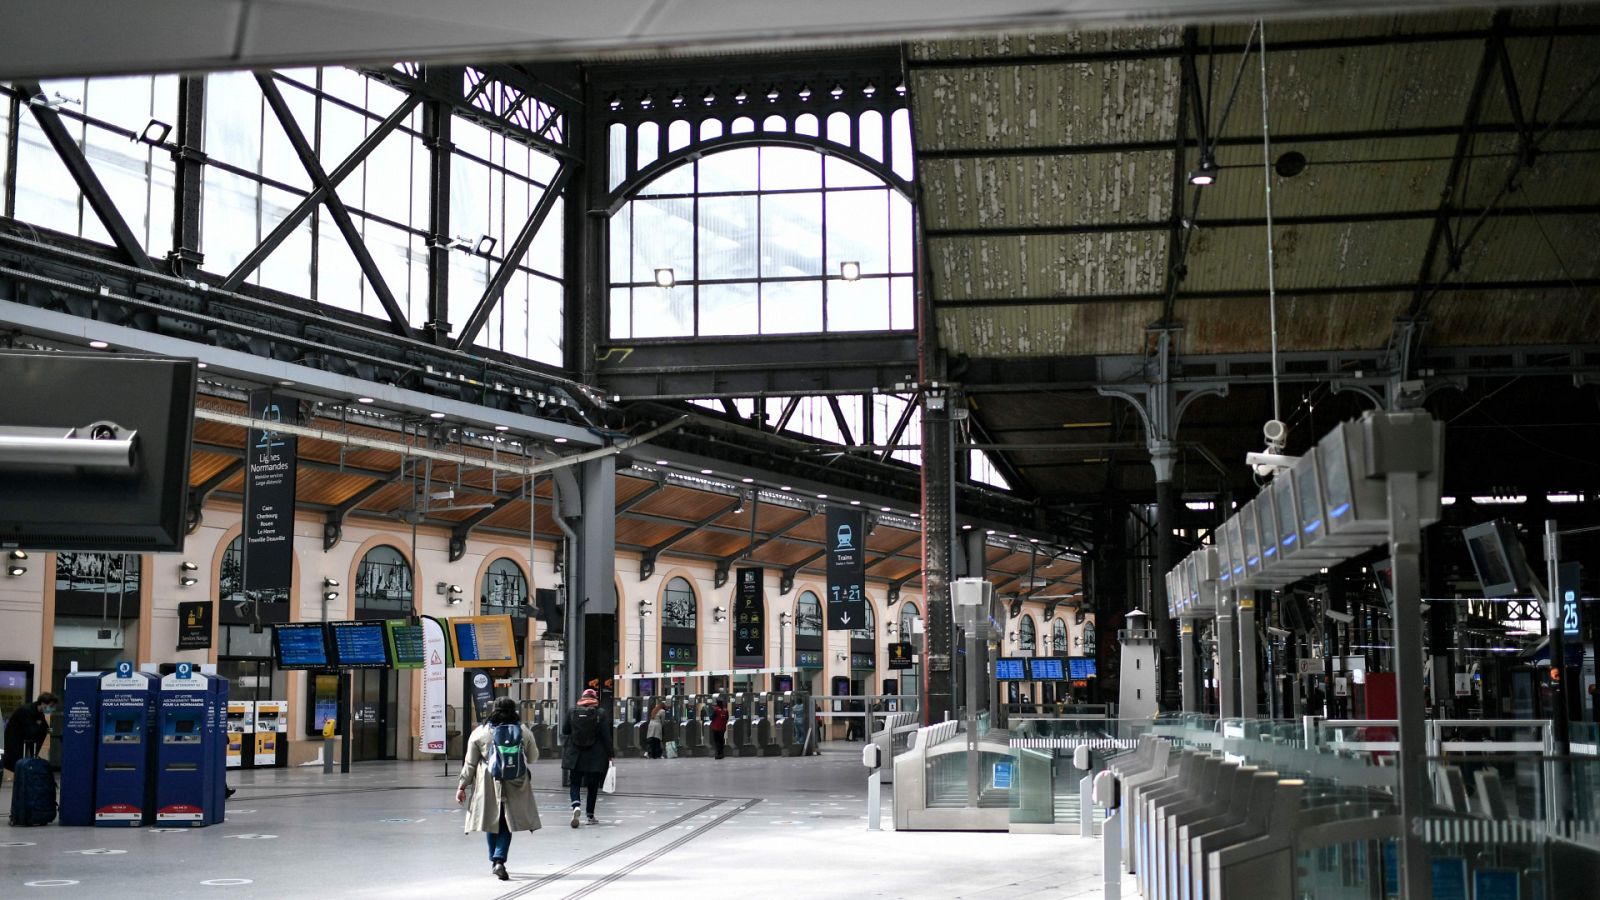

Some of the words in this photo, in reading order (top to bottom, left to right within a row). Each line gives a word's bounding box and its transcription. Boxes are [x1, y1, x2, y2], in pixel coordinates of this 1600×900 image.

[259, 453, 280, 464] Lignes
[251, 462, 289, 472] Normandes
[833, 590, 840, 601] 1
[848, 589, 860, 600] 21
[1563, 603, 1578, 629] 25
